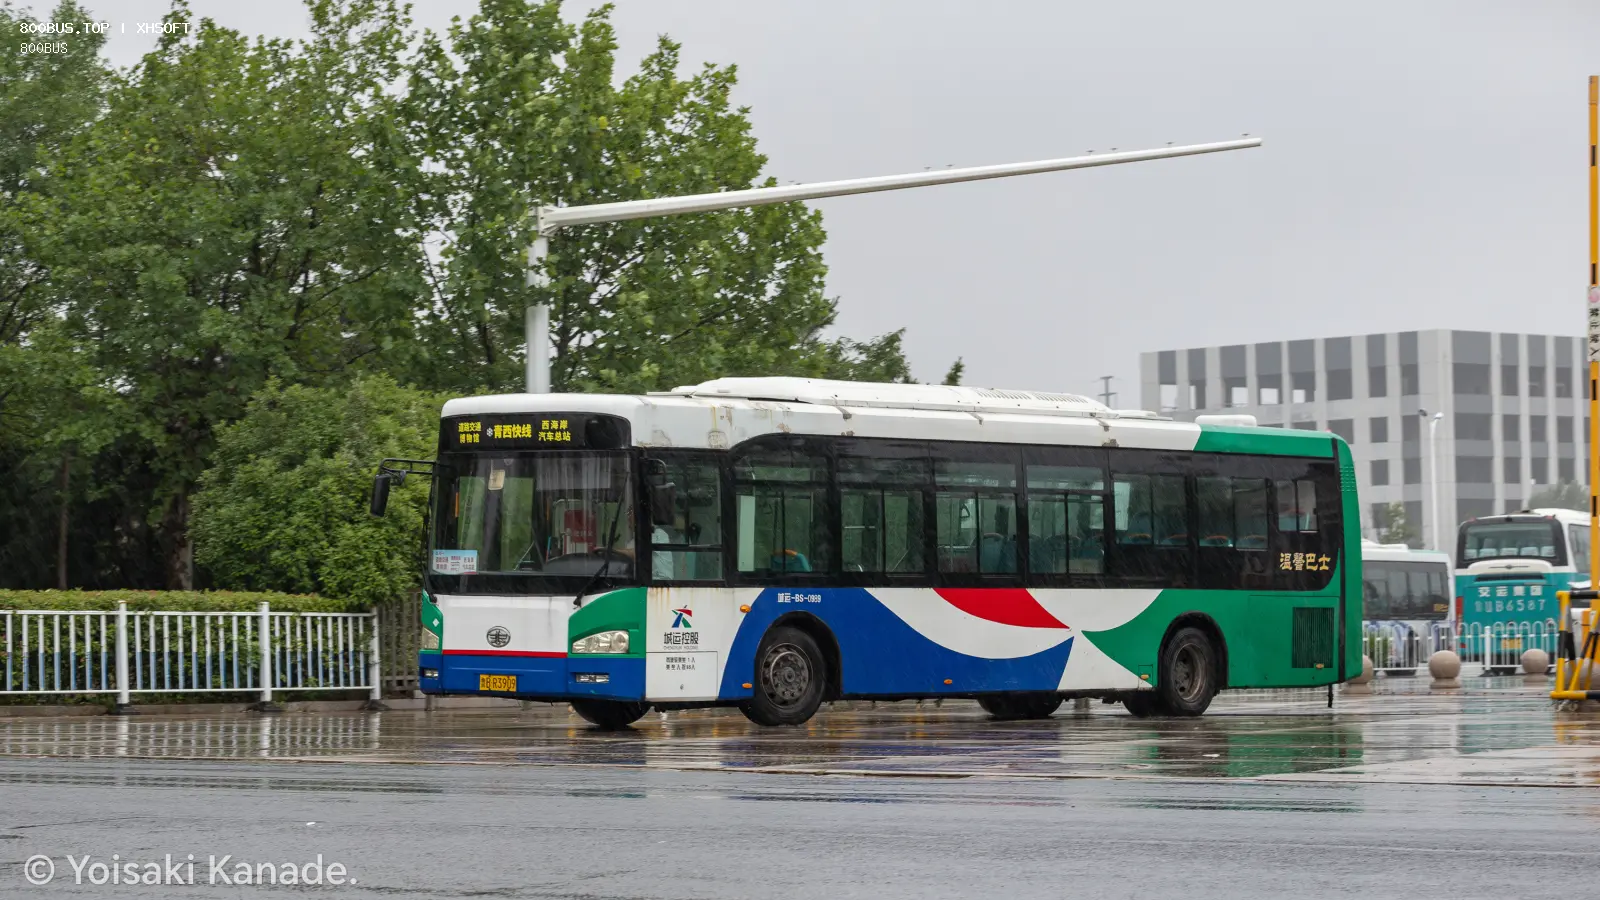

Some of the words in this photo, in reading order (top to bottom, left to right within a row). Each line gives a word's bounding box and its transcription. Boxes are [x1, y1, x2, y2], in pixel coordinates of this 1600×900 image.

[541, 420, 568, 430] 西海岸
[494, 424, 532, 439] 青西快线
[539, 431, 571, 441] 汽车总站
[664, 632, 698, 645] 城运控股
